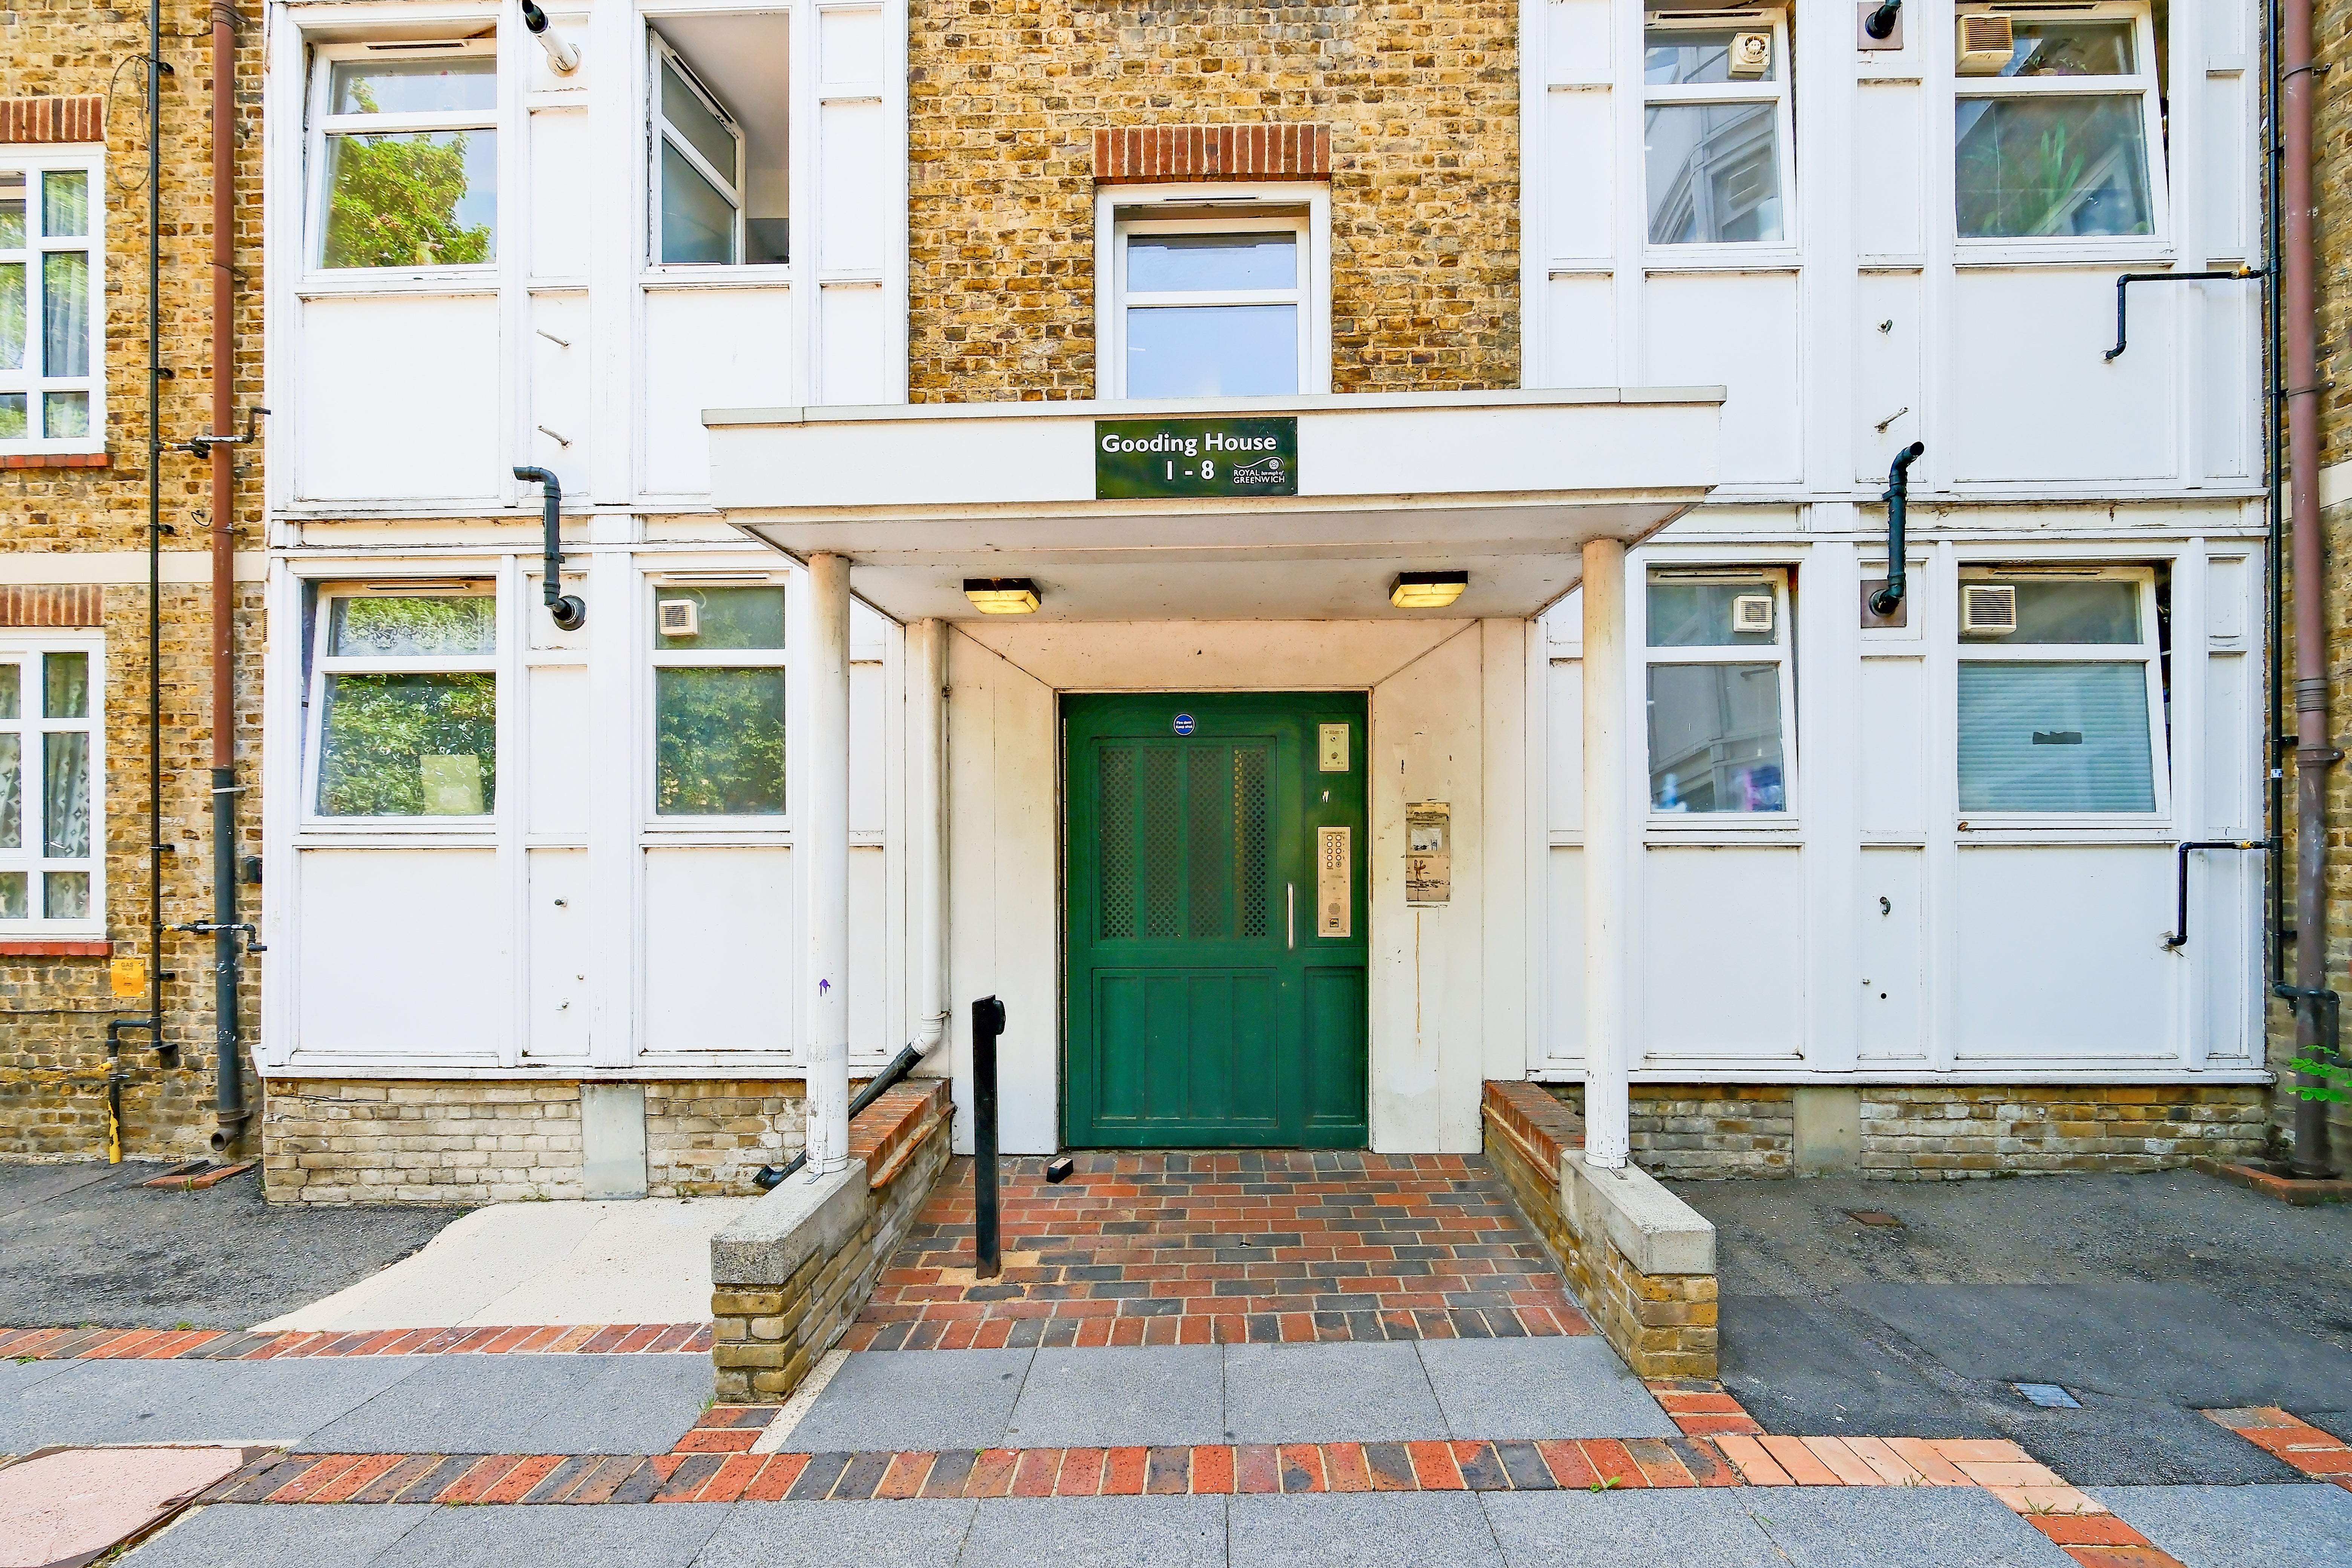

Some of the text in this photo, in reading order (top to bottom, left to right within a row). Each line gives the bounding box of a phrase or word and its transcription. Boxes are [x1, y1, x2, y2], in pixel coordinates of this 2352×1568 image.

[1101, 433, 1277, 456] Gooding House
[1201, 460, 1214, 479] 8
[1233, 476, 1285, 484] GREENWICH
